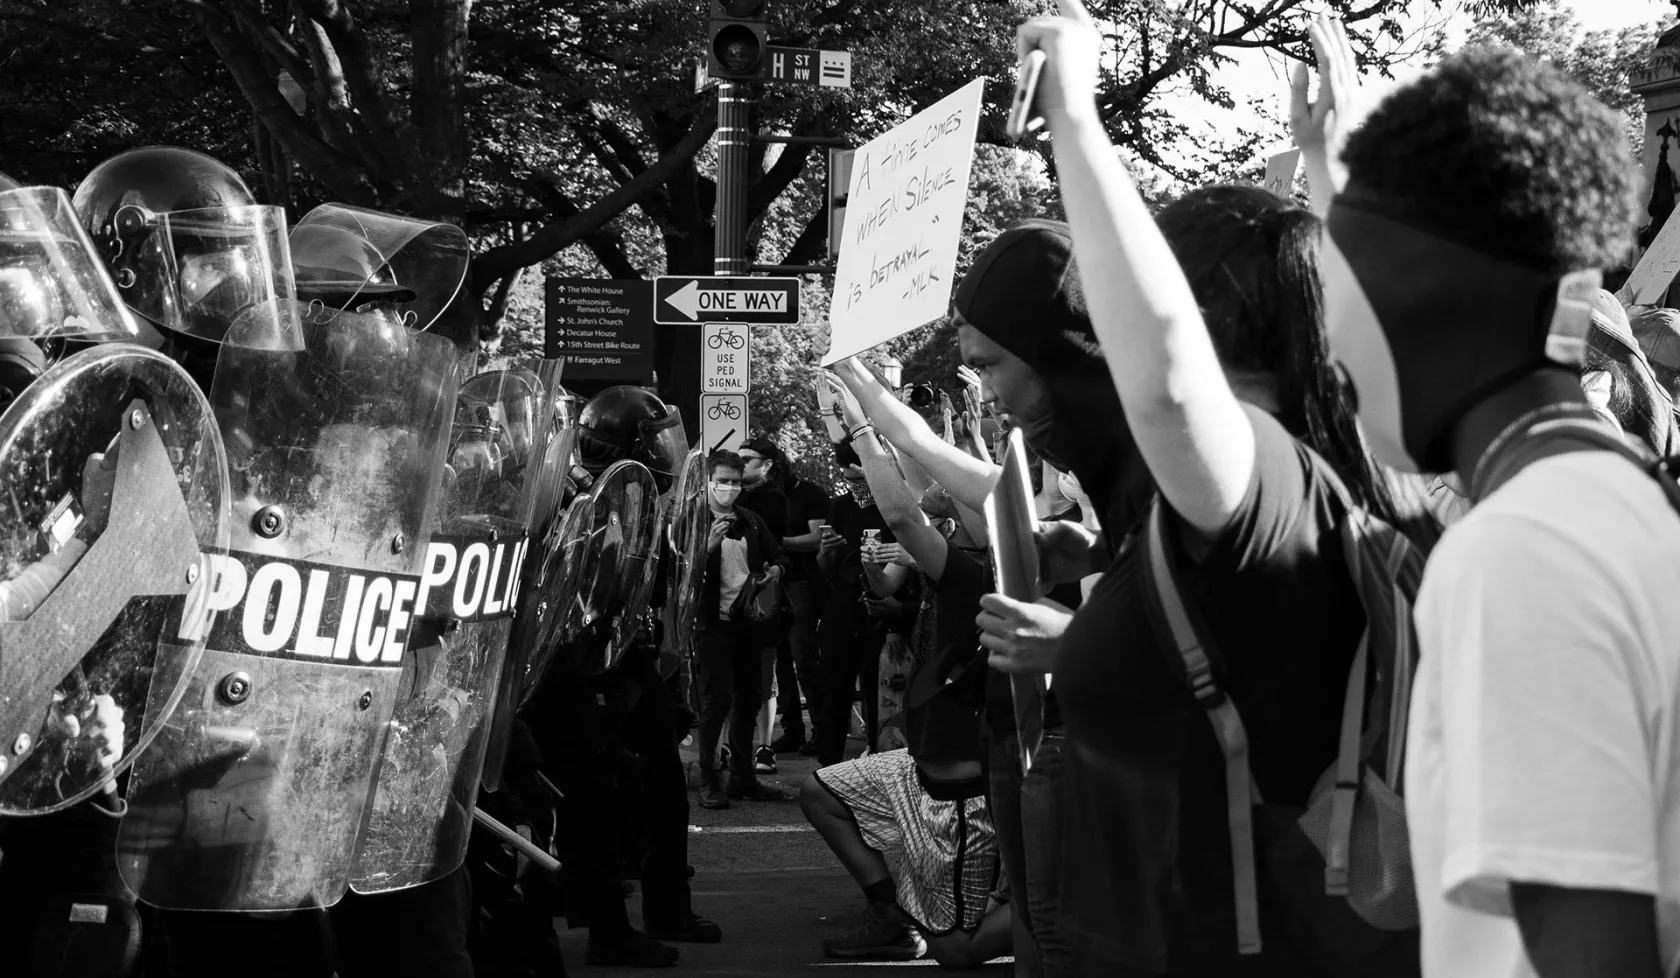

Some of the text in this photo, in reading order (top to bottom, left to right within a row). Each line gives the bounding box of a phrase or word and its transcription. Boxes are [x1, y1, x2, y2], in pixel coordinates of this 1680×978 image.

[772, 53, 811, 79] H ST
[794, 68, 810, 81] NW
[855, 152, 871, 199] A
[856, 188, 901, 246] WHEN
[566, 286, 623, 295] The White House
[698, 291, 785, 310] ONE WAY
[576, 306, 630, 316] Renwick Gallery
[576, 317, 597, 326] John's
[598, 318, 623, 326] Church
[566, 329, 616, 338] Decatur House
[566, 341, 640, 350] 15th Street Bike Route
[574, 356, 603, 366] Farragut
[603, 356, 621, 365] West
[716, 353, 735, 364] USE
[716, 365, 735, 376] PED
[708, 377, 743, 388] SIGNAL
[177, 551, 417, 664] POLICE
